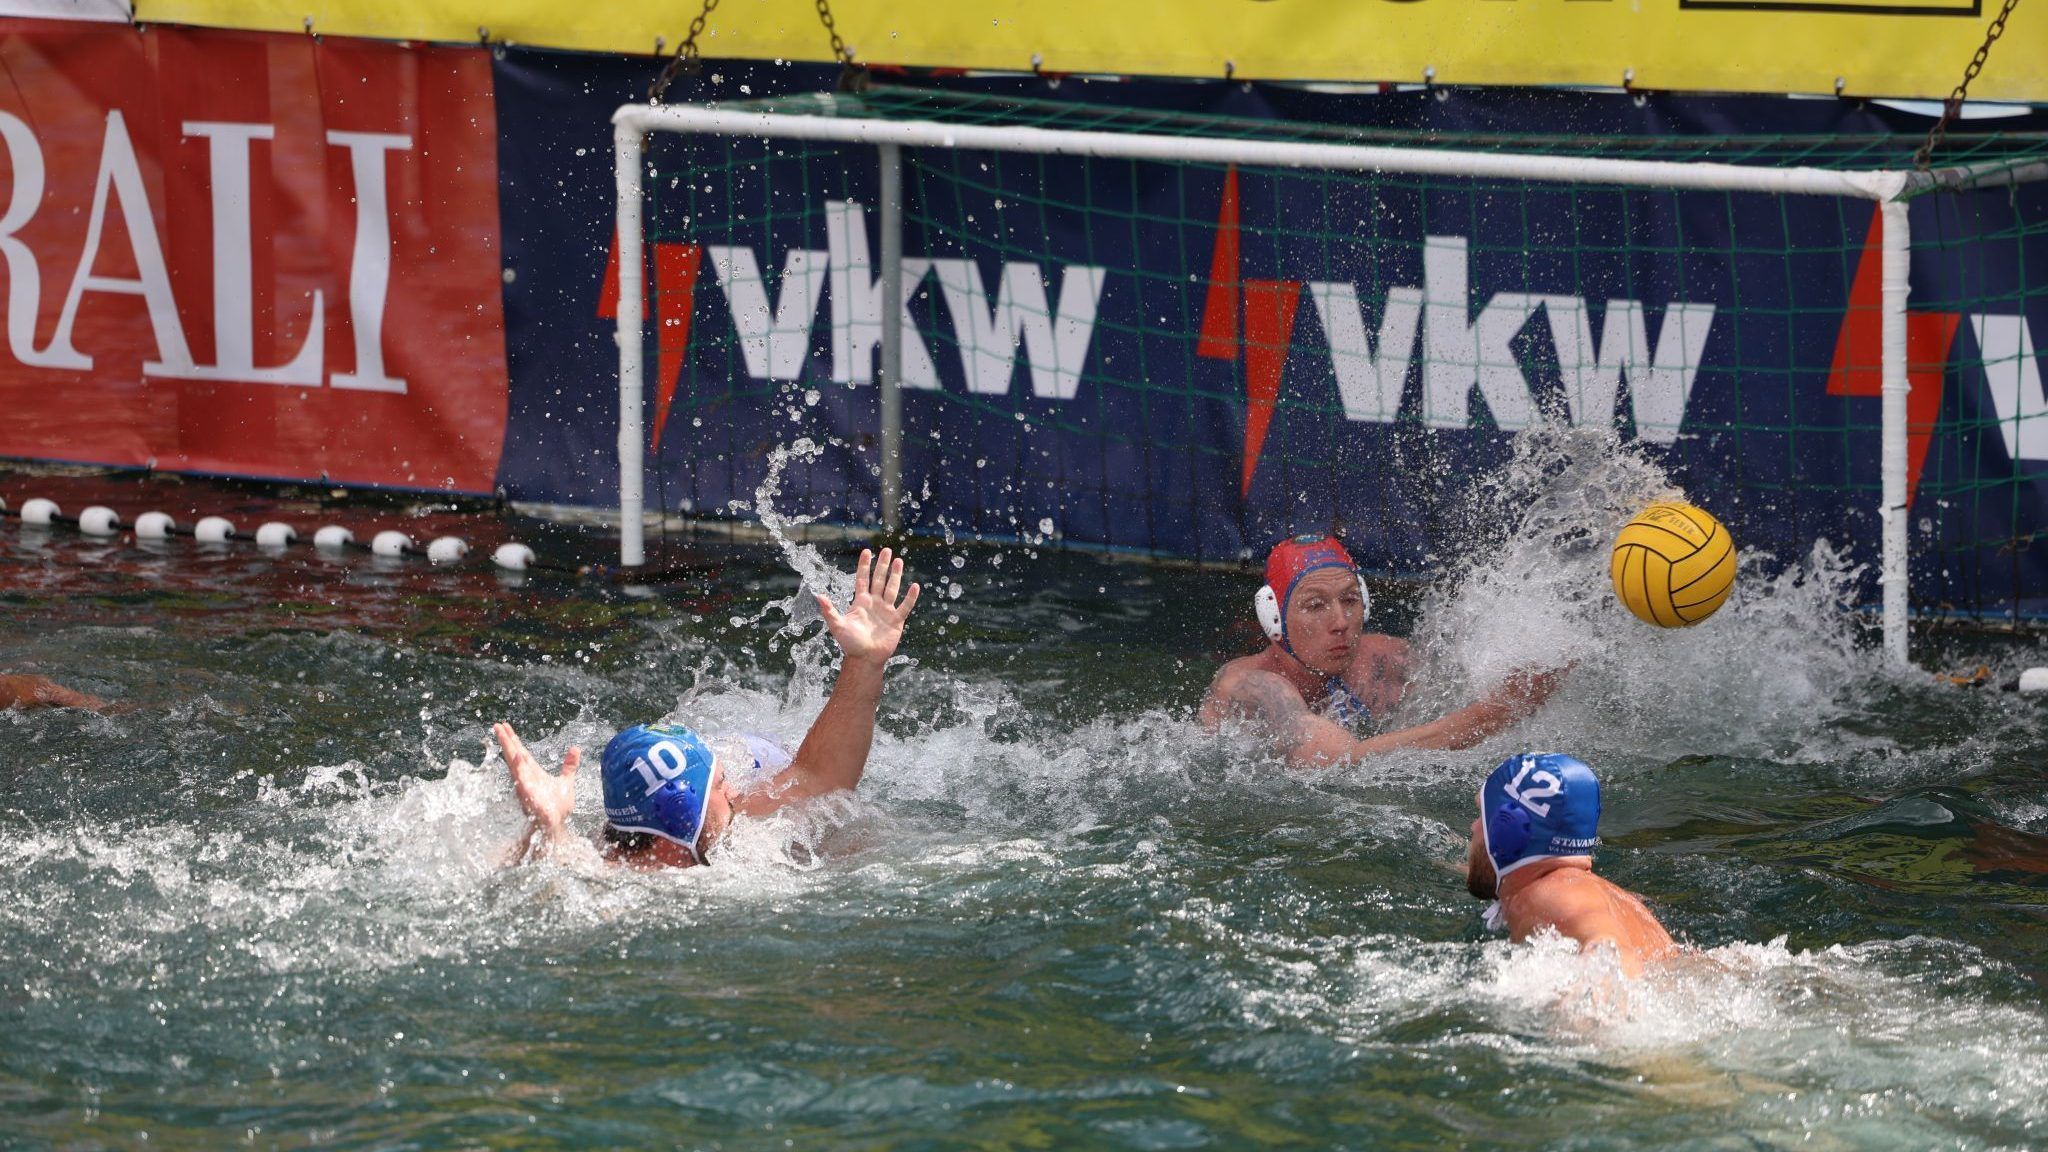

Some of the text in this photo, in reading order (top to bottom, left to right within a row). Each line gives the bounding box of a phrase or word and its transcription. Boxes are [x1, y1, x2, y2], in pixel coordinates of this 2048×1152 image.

[708, 200, 1107, 399] vkw
[1309, 235, 1716, 446] vkw
[629, 740, 687, 797] 10
[1503, 756, 1562, 818] 12
